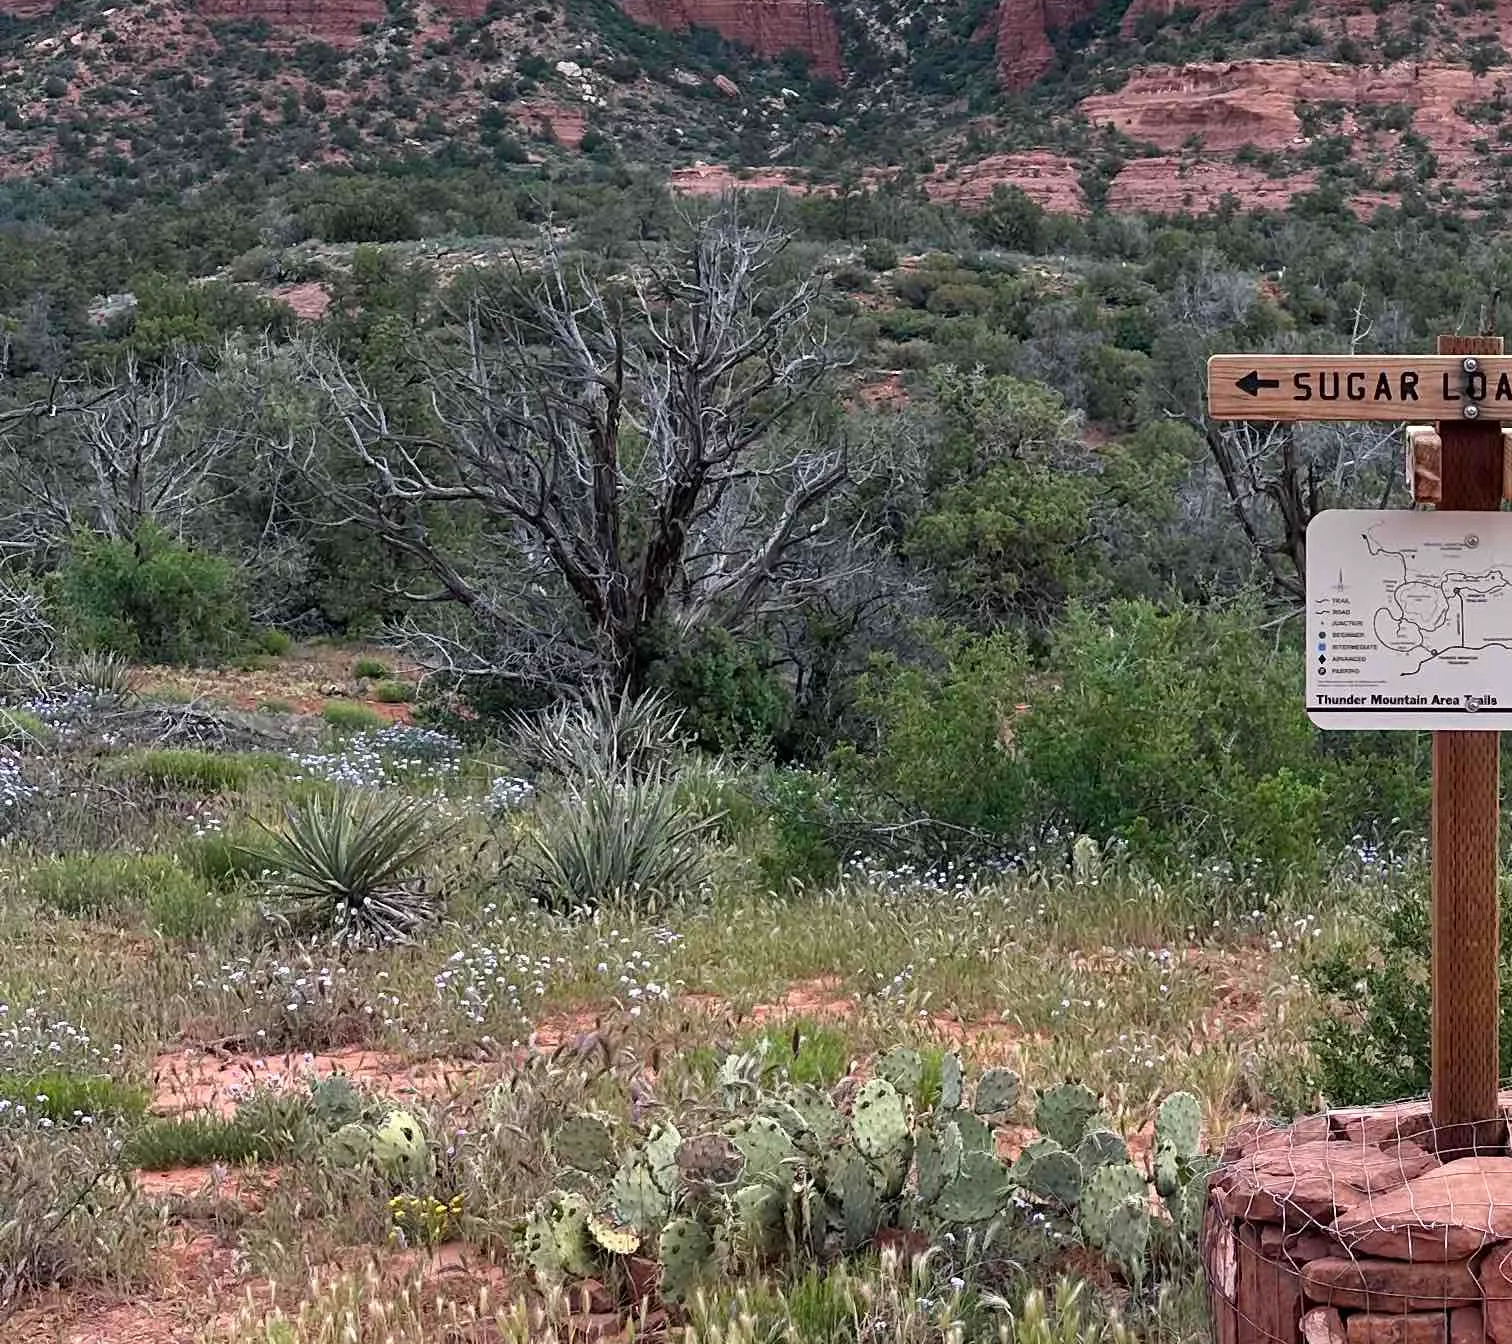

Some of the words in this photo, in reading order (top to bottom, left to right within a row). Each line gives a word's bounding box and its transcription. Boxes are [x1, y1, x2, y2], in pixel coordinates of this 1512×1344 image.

[1293, 371, 1420, 402] SUGAR
[1316, 694, 1367, 706] Thunder
[1370, 694, 1428, 706] Mountain
[1431, 694, 1460, 706] Area
[1464, 694, 1498, 706] Tails
